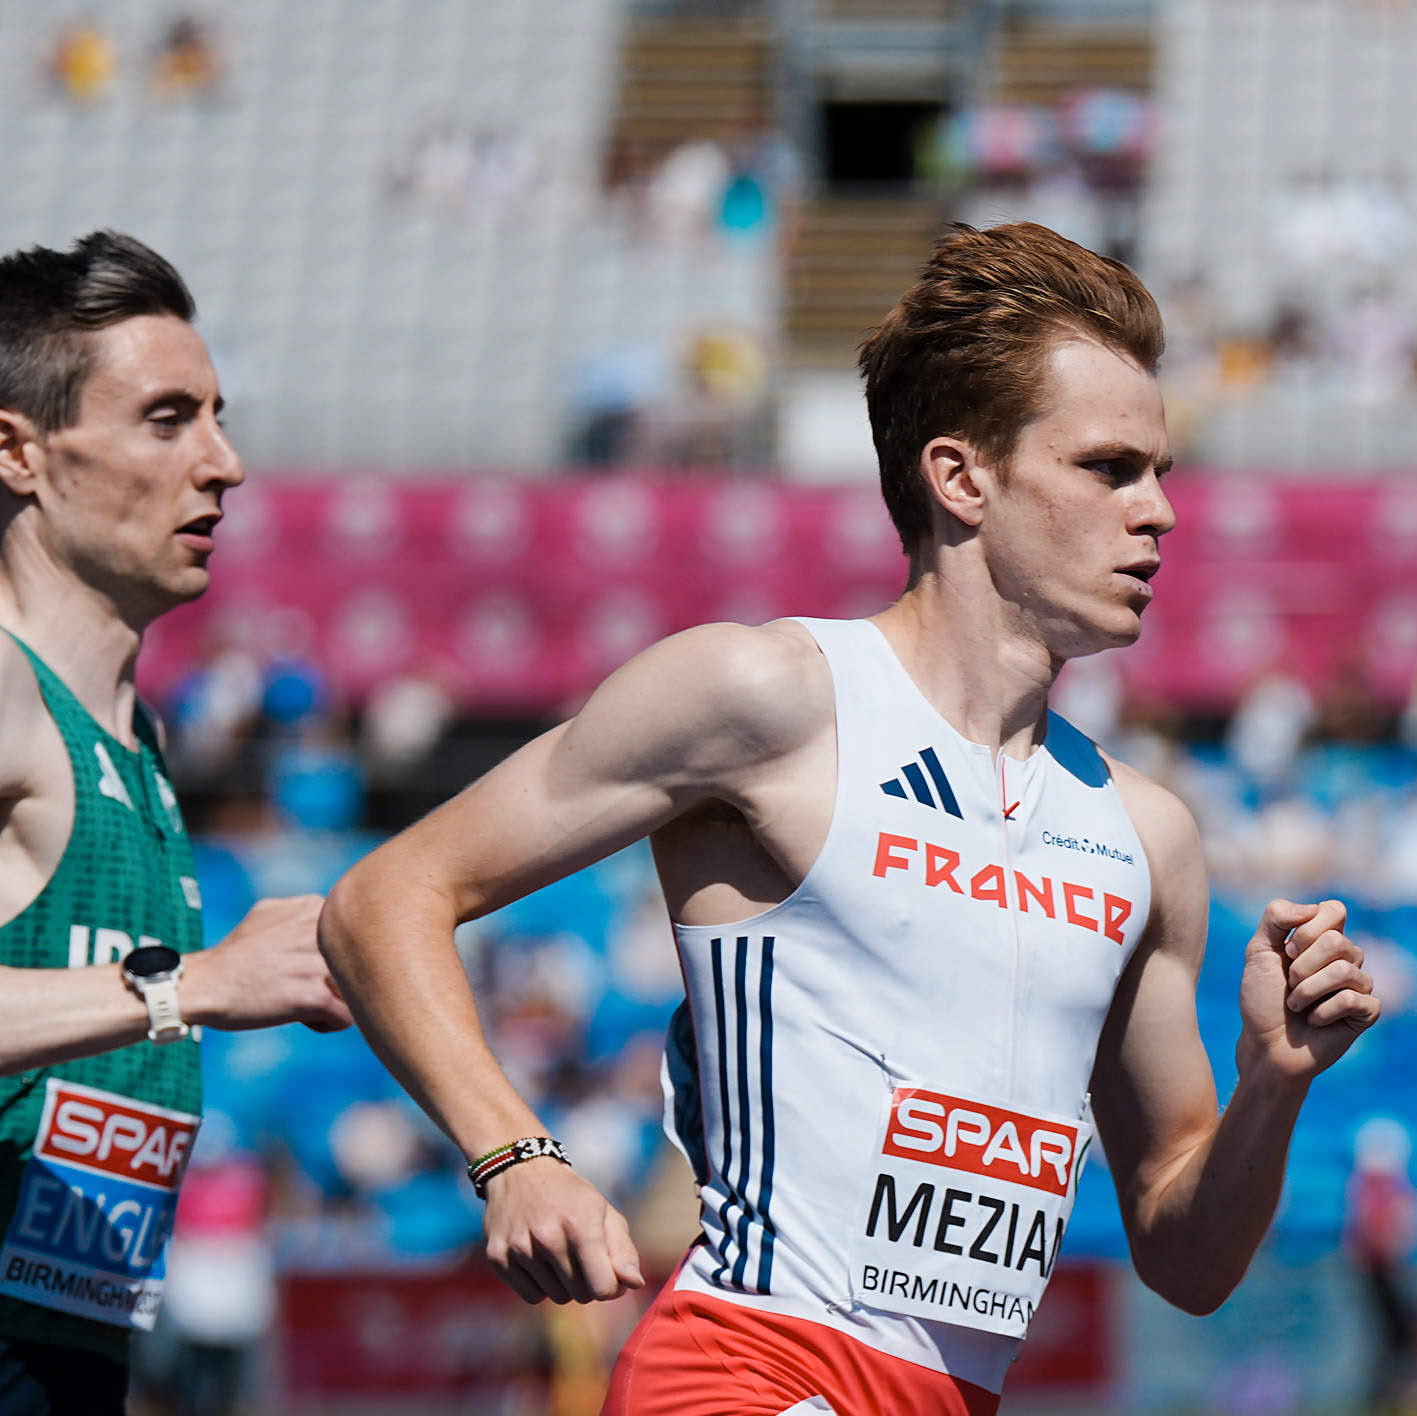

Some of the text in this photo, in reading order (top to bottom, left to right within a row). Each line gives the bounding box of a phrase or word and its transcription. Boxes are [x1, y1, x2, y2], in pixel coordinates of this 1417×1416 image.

[872, 831, 1133, 947] FRANCE
[1042, 831, 1135, 866] Crédit Mutuel
[892, 1097, 1073, 1186] SPAR
